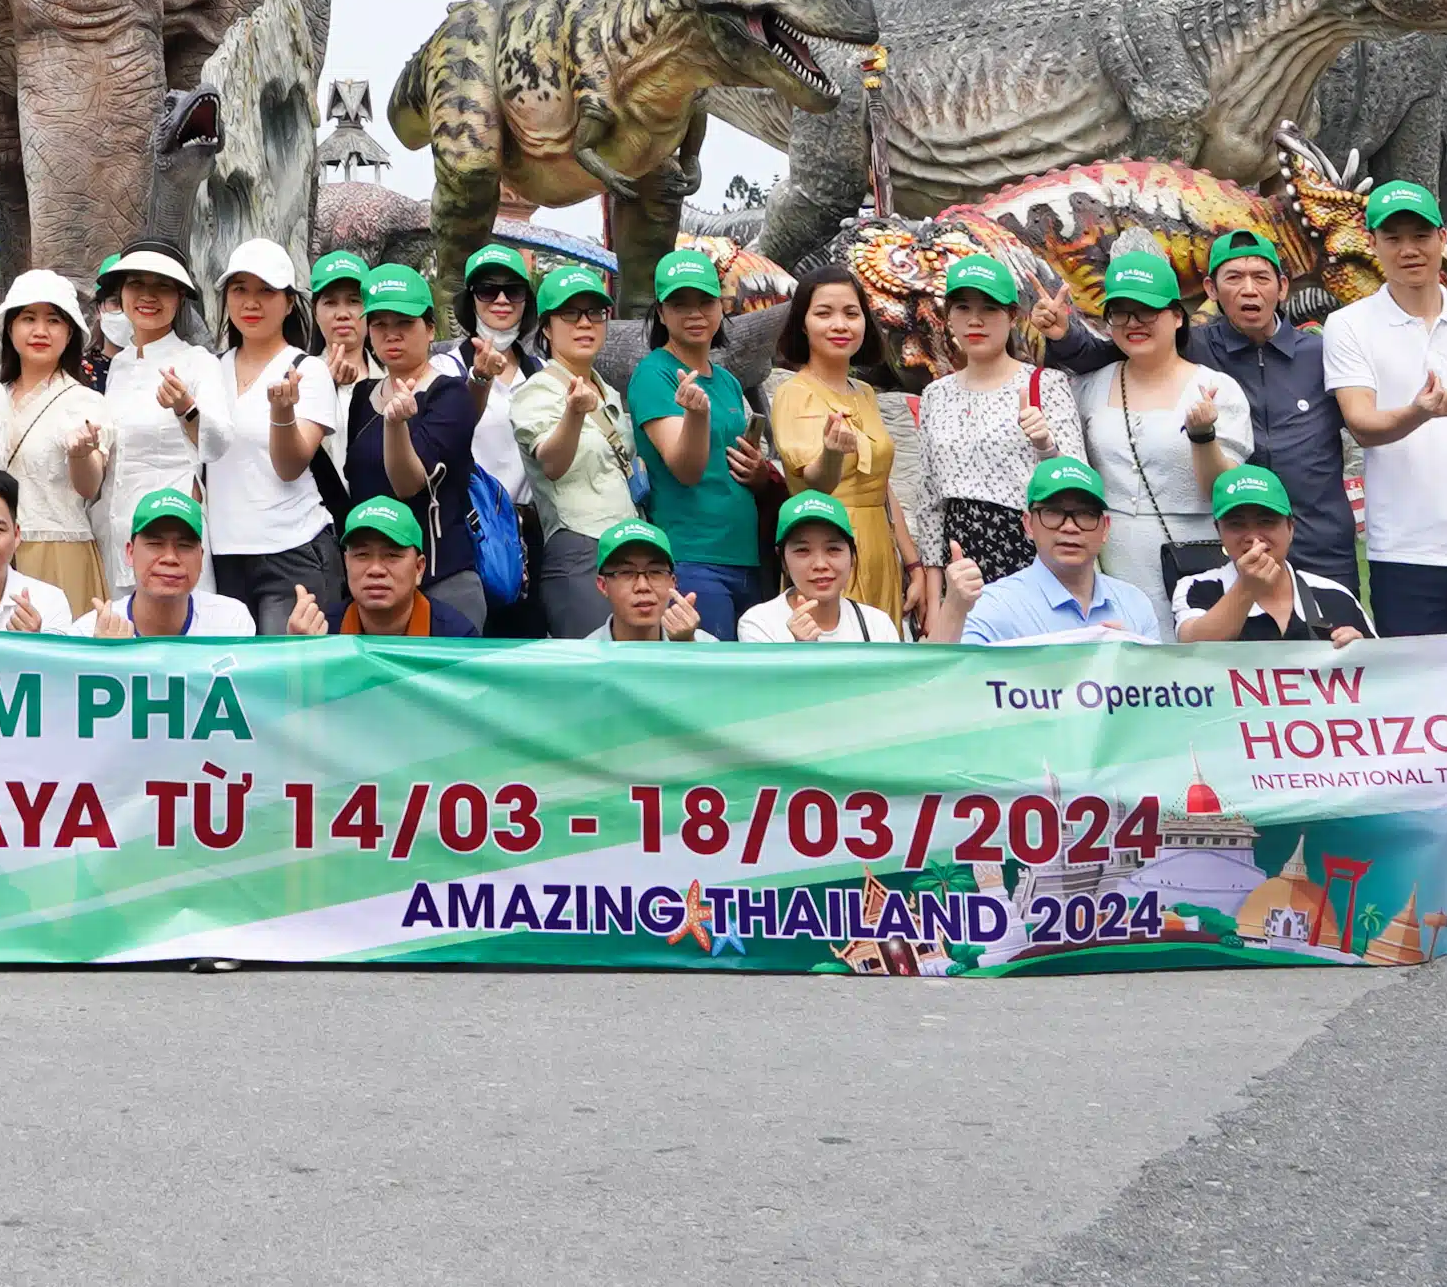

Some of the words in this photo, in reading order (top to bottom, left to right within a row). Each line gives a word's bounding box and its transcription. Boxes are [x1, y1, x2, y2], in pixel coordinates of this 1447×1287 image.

[77, 653, 254, 741] PHÁ
[986, 680, 1063, 710] Tour
[1076, 680, 1215, 715] Operator
[1228, 666, 1365, 708] NEW
[1252, 766, 1431, 790] INTERNATIONAL
[145, 761, 252, 850] TỪ
[284, 781, 543, 859] 14/03
[630, 784, 1163, 870] 18/03/2024
[401, 881, 686, 936] AMAZING
[706, 886, 1009, 945] THAILAND
[1029, 891, 1163, 945] 2024
